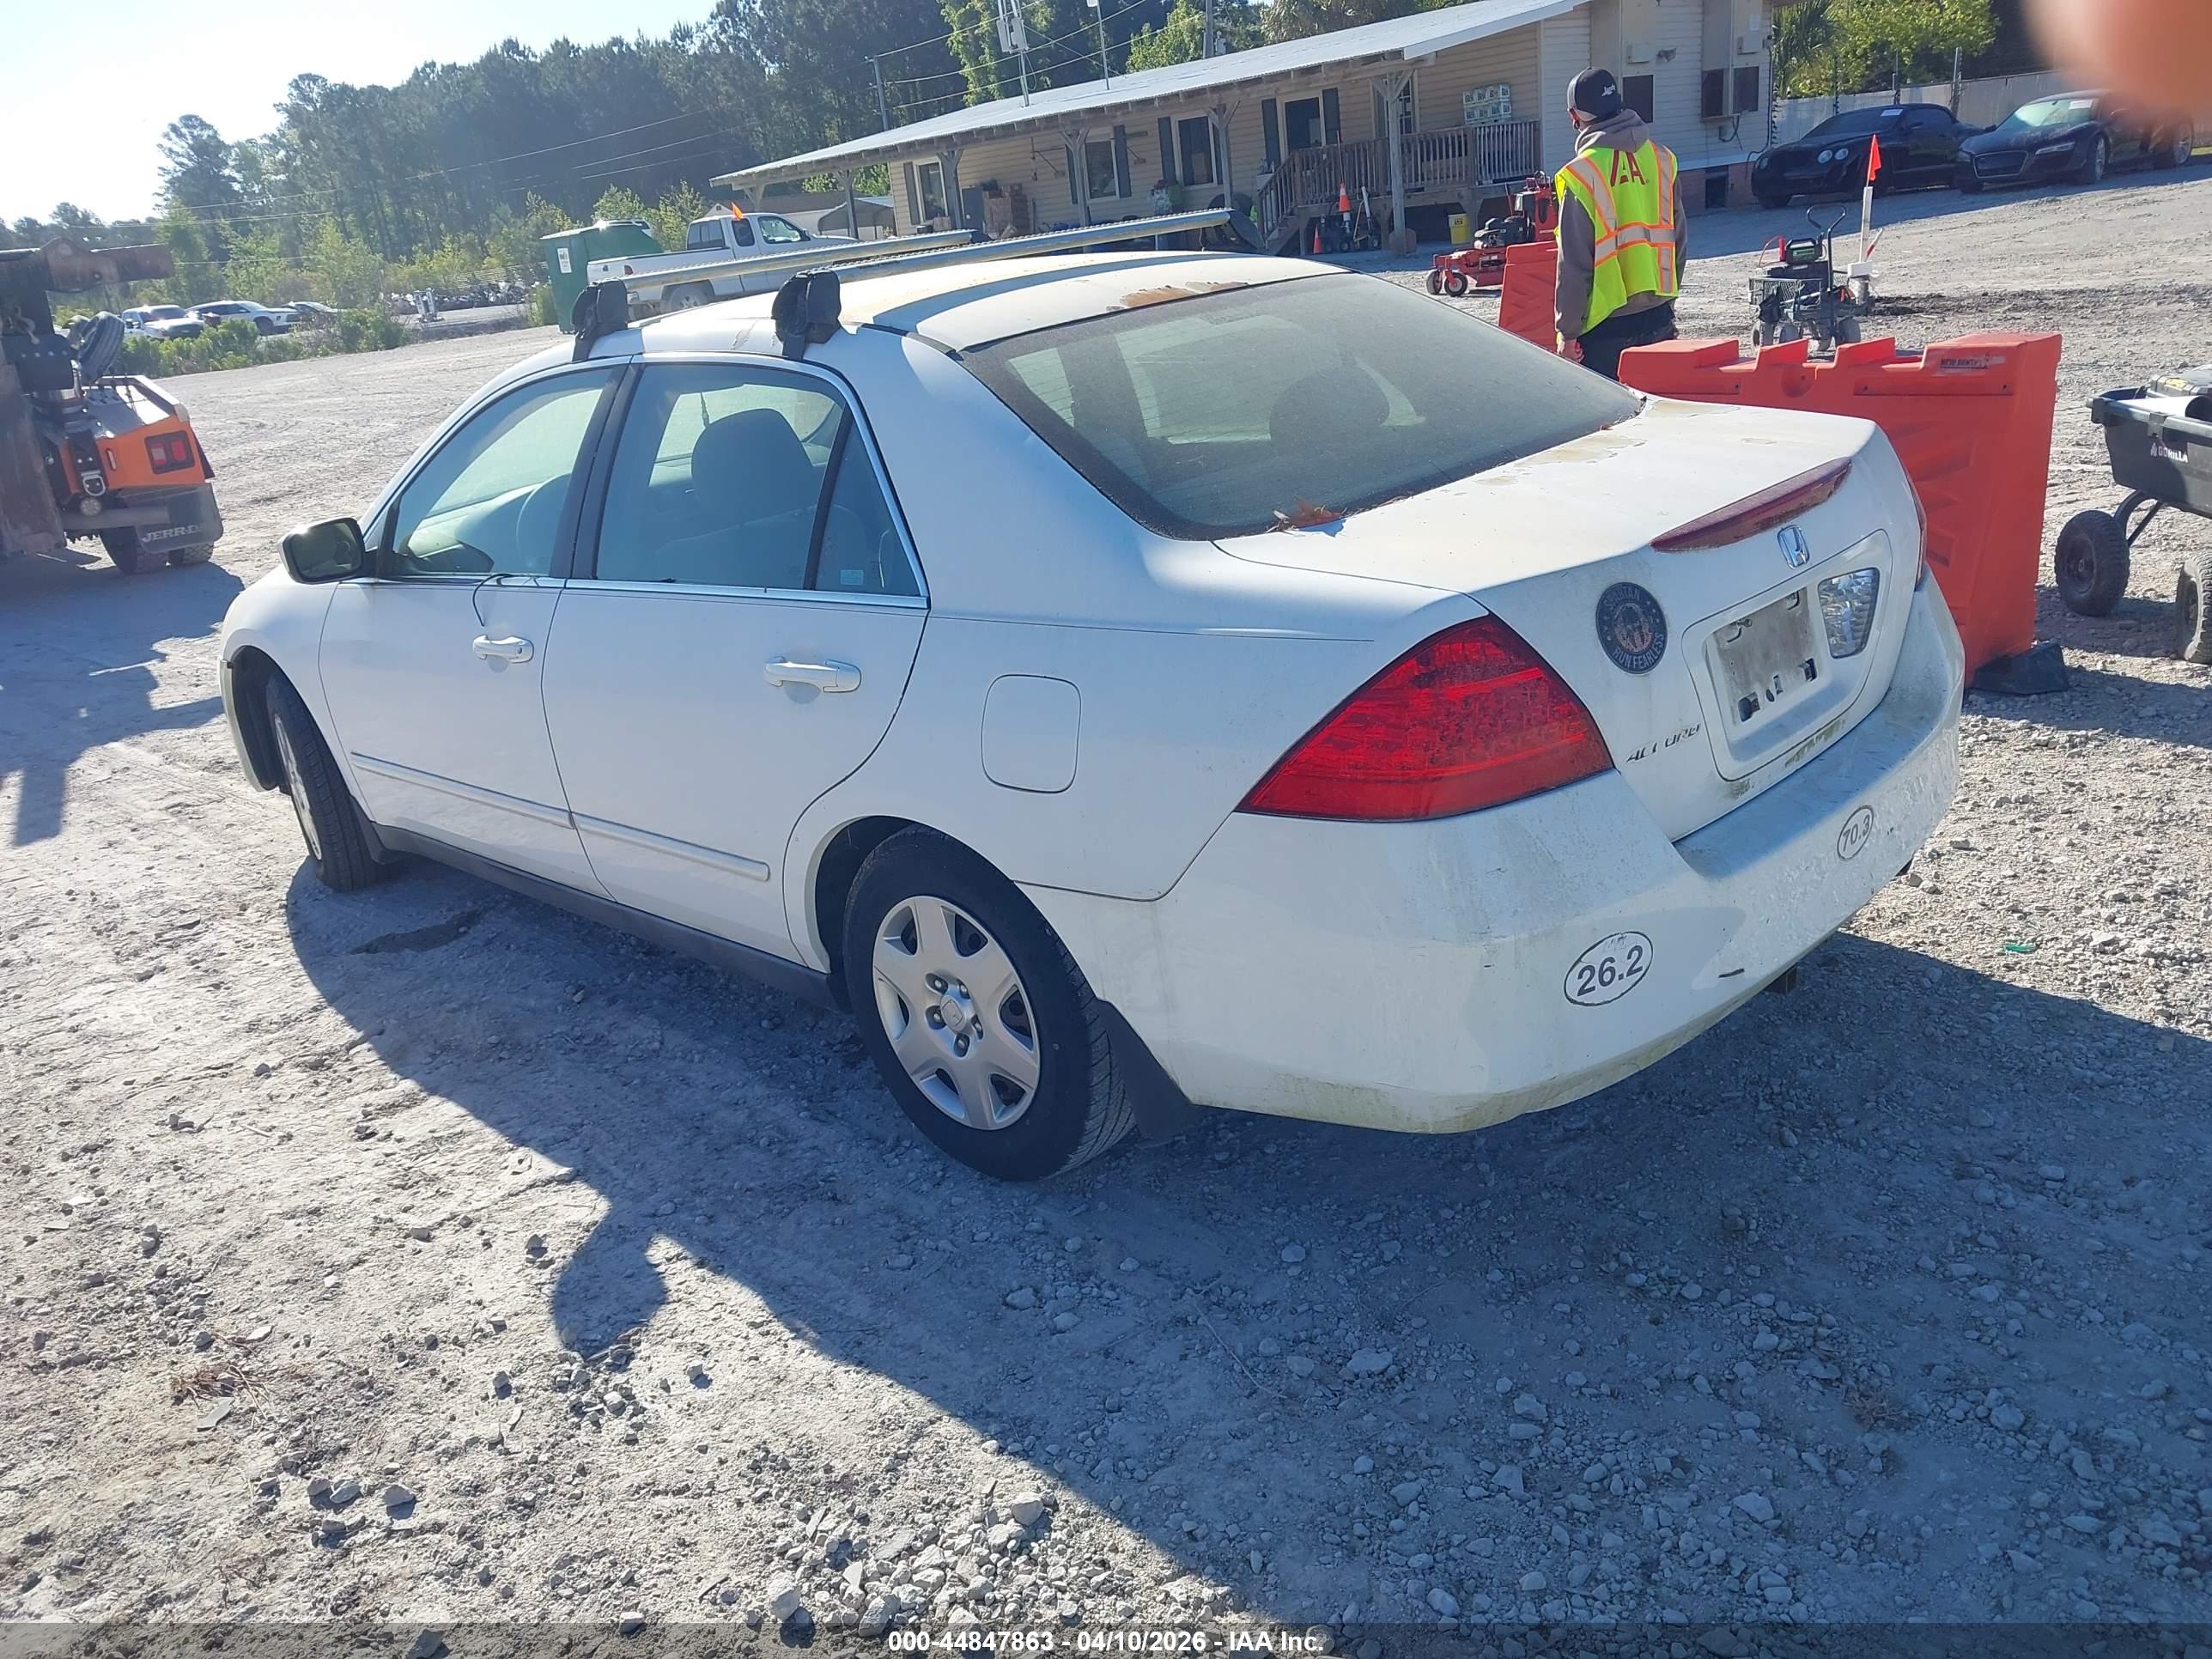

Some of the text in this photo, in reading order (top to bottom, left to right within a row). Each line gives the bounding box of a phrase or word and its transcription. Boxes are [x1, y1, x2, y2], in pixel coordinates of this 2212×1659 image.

[2158, 446, 2189, 464] GORILLA
[1612, 632, 1665, 670] RUN FEARLESS
[1843, 814, 1870, 852] 70.3
[1577, 945, 1644, 997] 26.2
